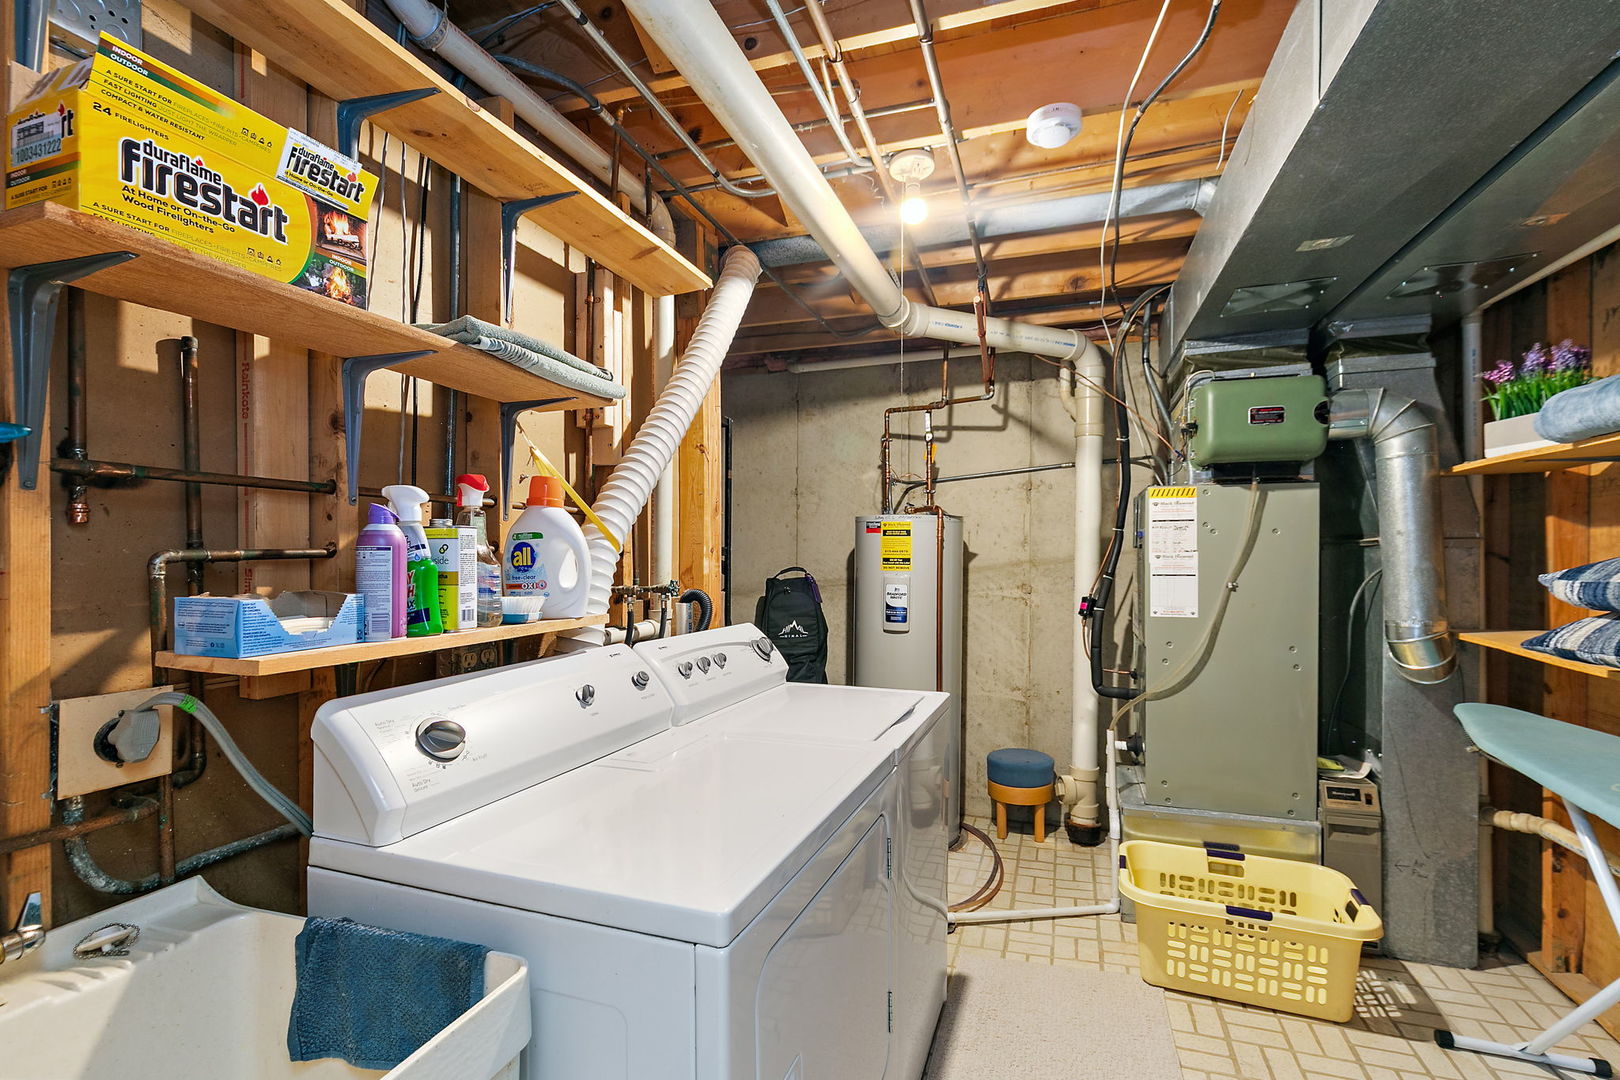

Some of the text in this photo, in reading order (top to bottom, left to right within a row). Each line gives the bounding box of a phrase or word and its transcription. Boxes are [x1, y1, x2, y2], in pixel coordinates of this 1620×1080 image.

[110, 54, 148, 76] OUTDOOR
[112, 46, 144, 65] INDOOR
[104, 79, 122, 91] FAST
[124, 89, 157, 108] LIGHTING
[114, 72, 133, 86] SURE
[135, 81, 157, 97] START
[158, 94, 172, 104] FOR
[92, 101, 169, 140] 24 FIRELIGHTERS
[101, 89, 137, 111] COMPACT
[145, 109, 168, 123] WATER
[170, 121, 205, 141] RESISTANT
[143, 140, 222, 185] duraflame
[298, 147, 334, 171] duraflame
[101, 204, 124, 216] SURE
[126, 213, 152, 226] START
[154, 222, 170, 233] FOR
[122, 185, 235, 232] At Home or On-the-Go
[122, 194, 154, 211] Wood
[157, 207, 214, 233] Firelighters
[329, 259, 354, 272] OUTDOOR
[332, 254, 352, 265] INDOOR
[513, 547, 532, 566] all
